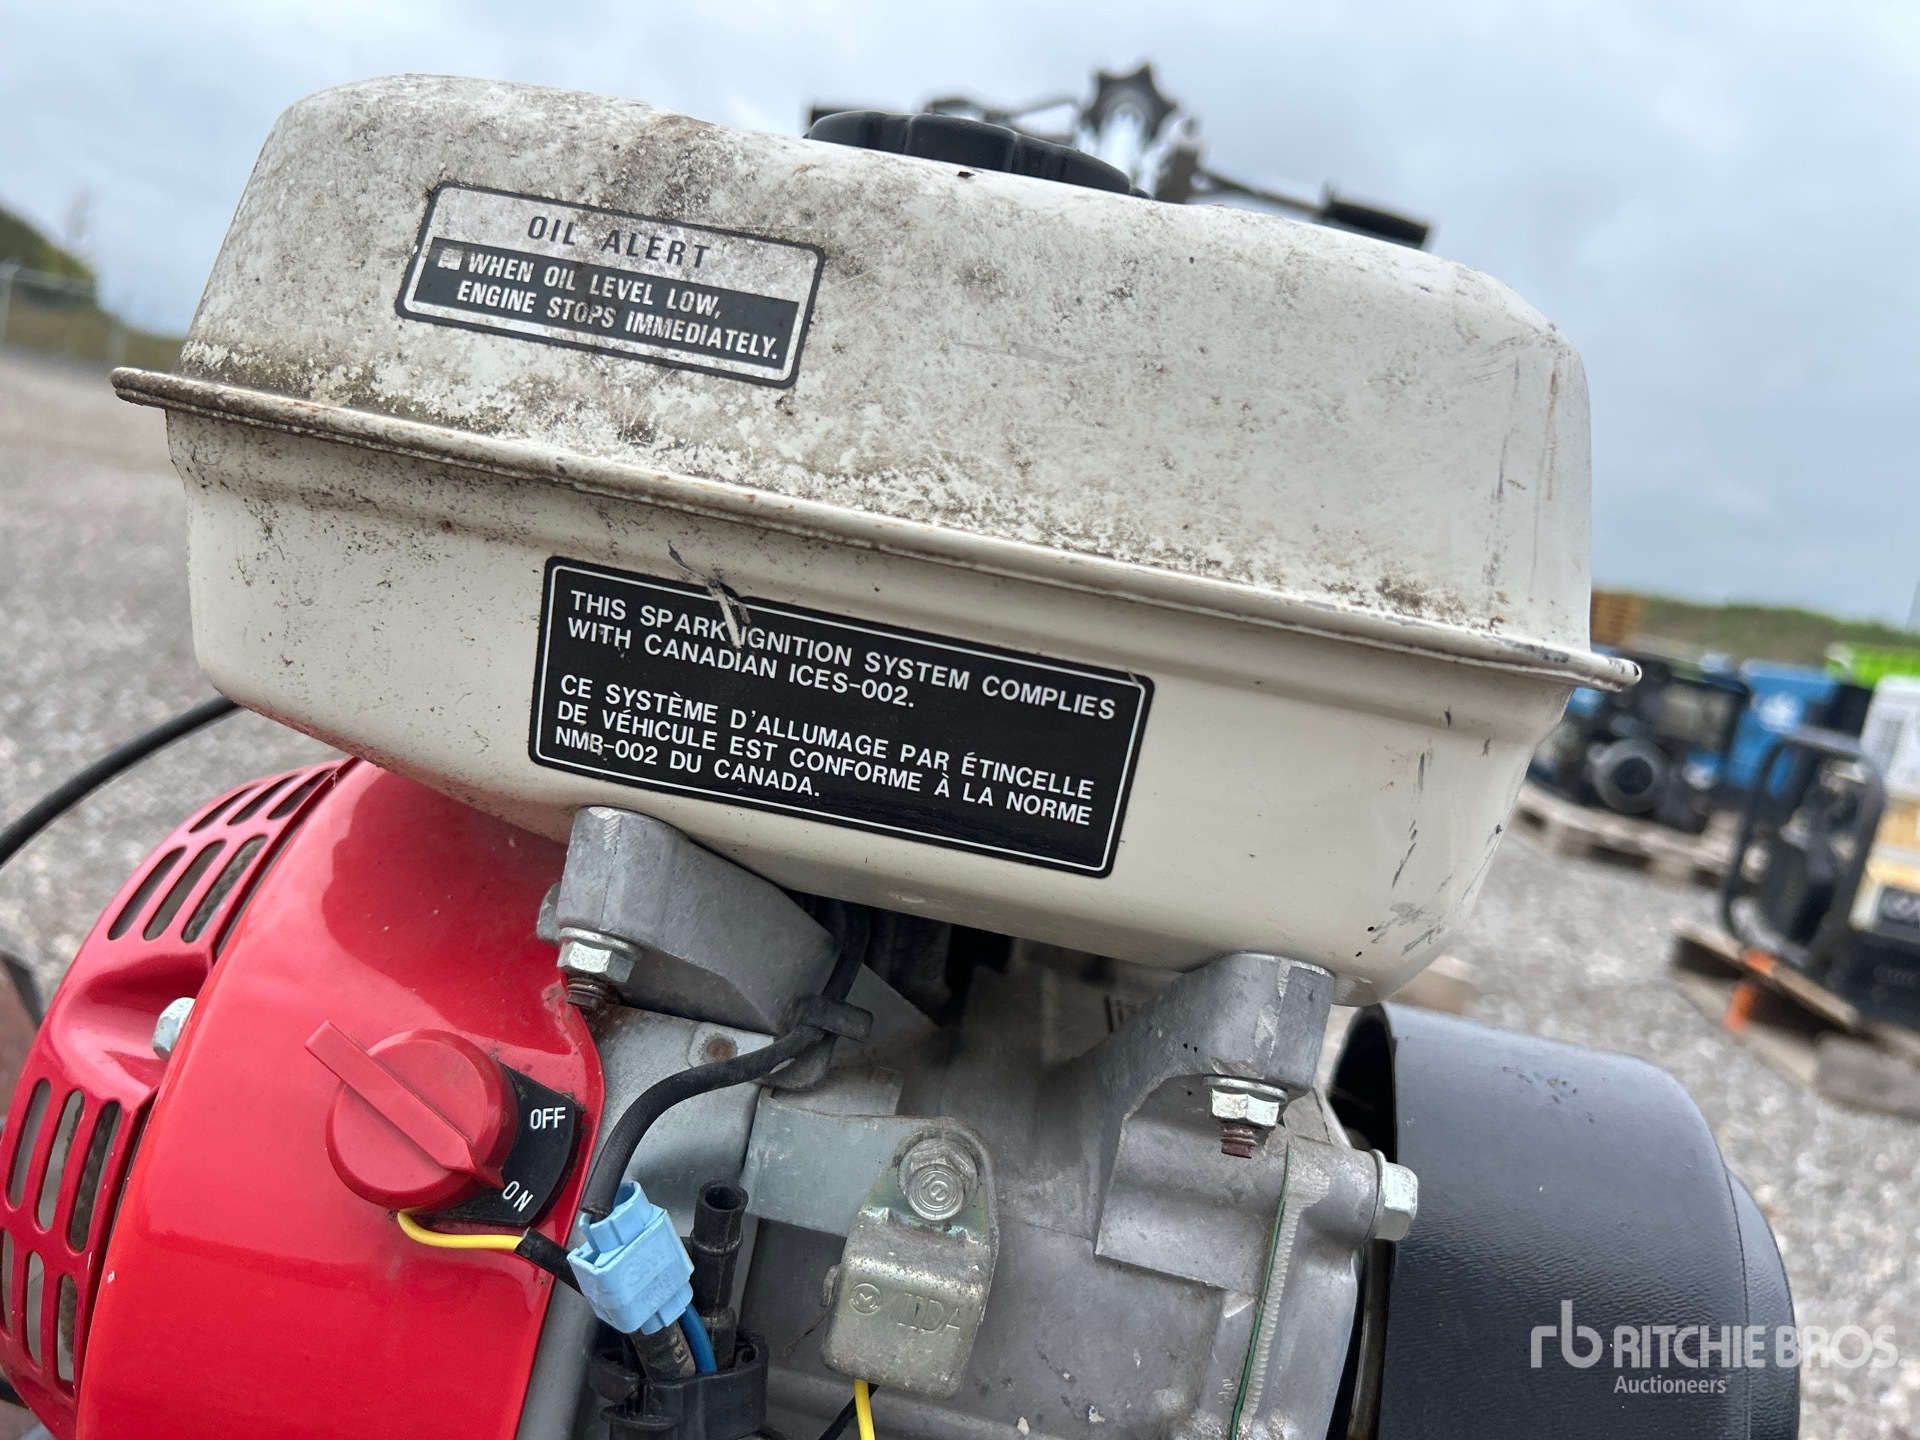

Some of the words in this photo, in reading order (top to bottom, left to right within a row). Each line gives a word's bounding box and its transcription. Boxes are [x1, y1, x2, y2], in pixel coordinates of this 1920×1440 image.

[528, 216, 576, 246] OIL
[601, 230, 710, 268] ALERT
[457, 280, 537, 314] ENGINE
[547, 298, 616, 329] STOPS
[625, 311, 778, 360] IMMEDIATELY.
[468, 252, 534, 284] WHEN
[543, 267, 576, 291] OIL
[589, 274, 654, 307] LEVEL
[666, 287, 721, 320] LOW,
[568, 617, 631, 649] WITH
[644, 634, 777, 678] CANADIAN
[789, 663, 915, 708] ICES-002.
[570, 590, 626, 621] THIS
[640, 605, 726, 642] SPARK
[740, 626, 852, 666] IGNITION
[864, 652, 970, 691] SYSTEM
[981, 676, 1116, 720] COMPLIES
[555, 726, 658, 765] NMB-002
[669, 750, 702, 774] DU
[714, 759, 820, 797] CANADA.
[558, 700, 588, 724] DE
[602, 709, 718, 751] VÉHICULE
[729, 736, 778, 761] EST
[789, 747, 922, 792] CONFORME
[934, 773, 950, 798] À
[962, 783, 993, 806] LA
[1006, 791, 1093, 826] NORME
[560, 674, 593, 699] CE
[605, 683, 718, 725] SYSTÈME
[730, 709, 889, 759] D'ALLUMAGE
[900, 744, 949, 771] PAR
[961, 752, 1094, 800] ÉTINCELLE
[530, 1107, 566, 1130] OFF
[502, 1181, 534, 1212] ON
